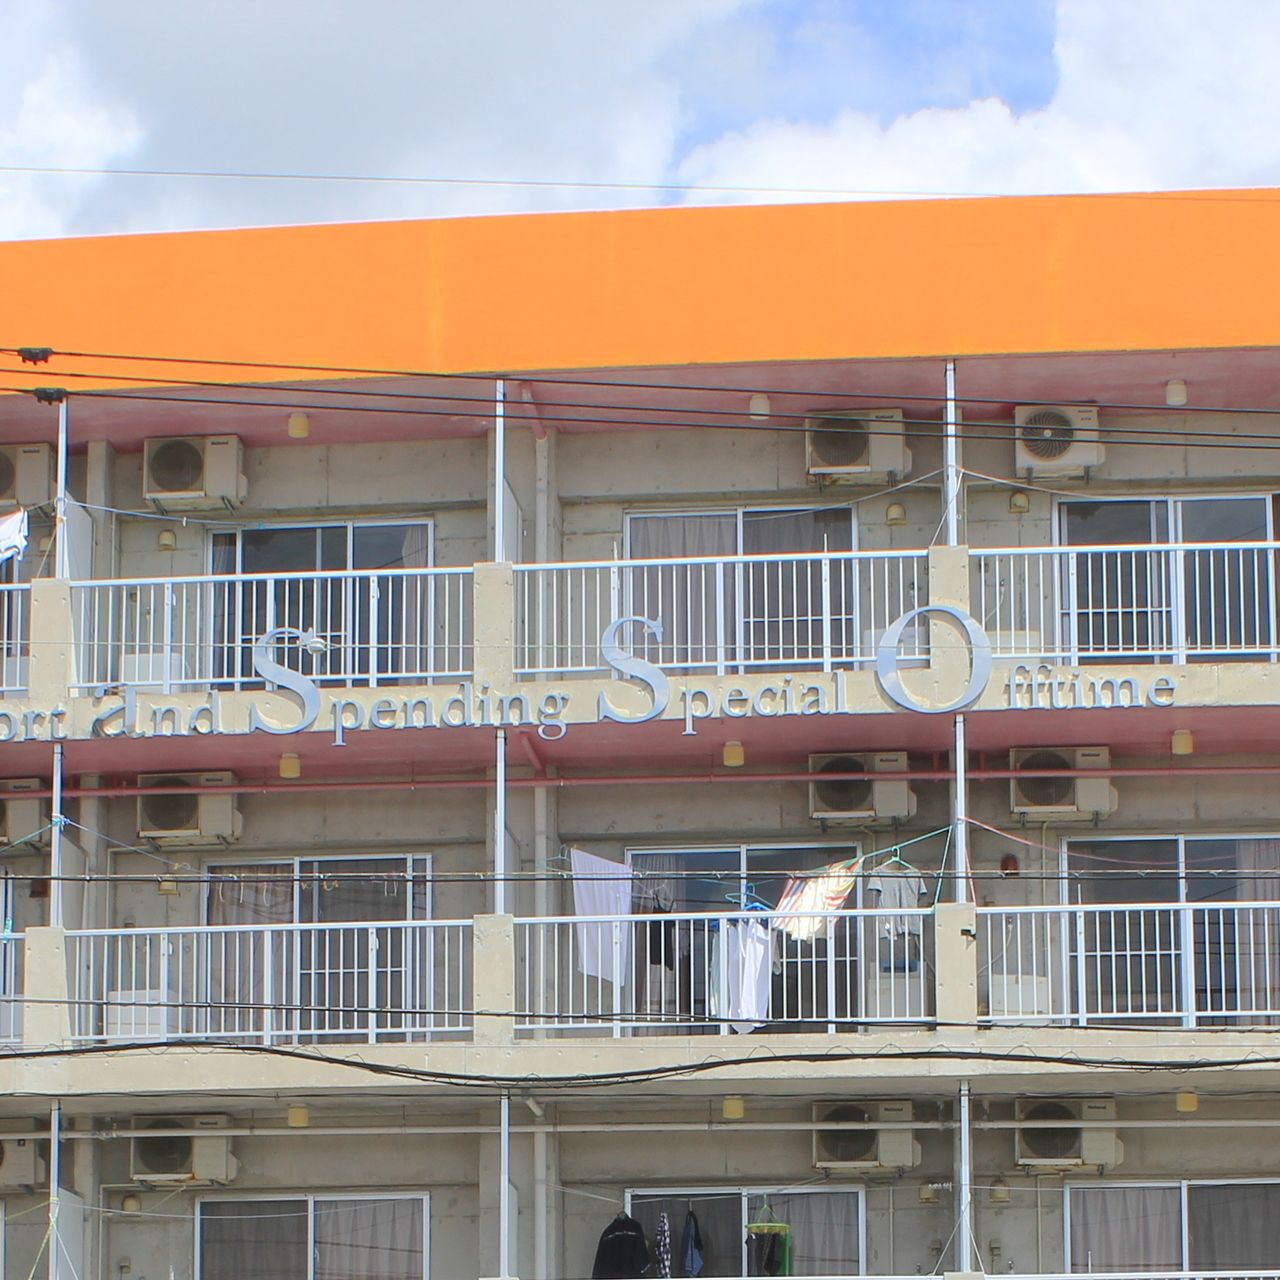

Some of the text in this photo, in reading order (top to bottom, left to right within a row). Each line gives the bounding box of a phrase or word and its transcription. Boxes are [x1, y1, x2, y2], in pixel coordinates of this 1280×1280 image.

[250, 627, 569, 747] Spending
[598, 615, 848, 735] Special
[876, 604, 1177, 714] Offtime
